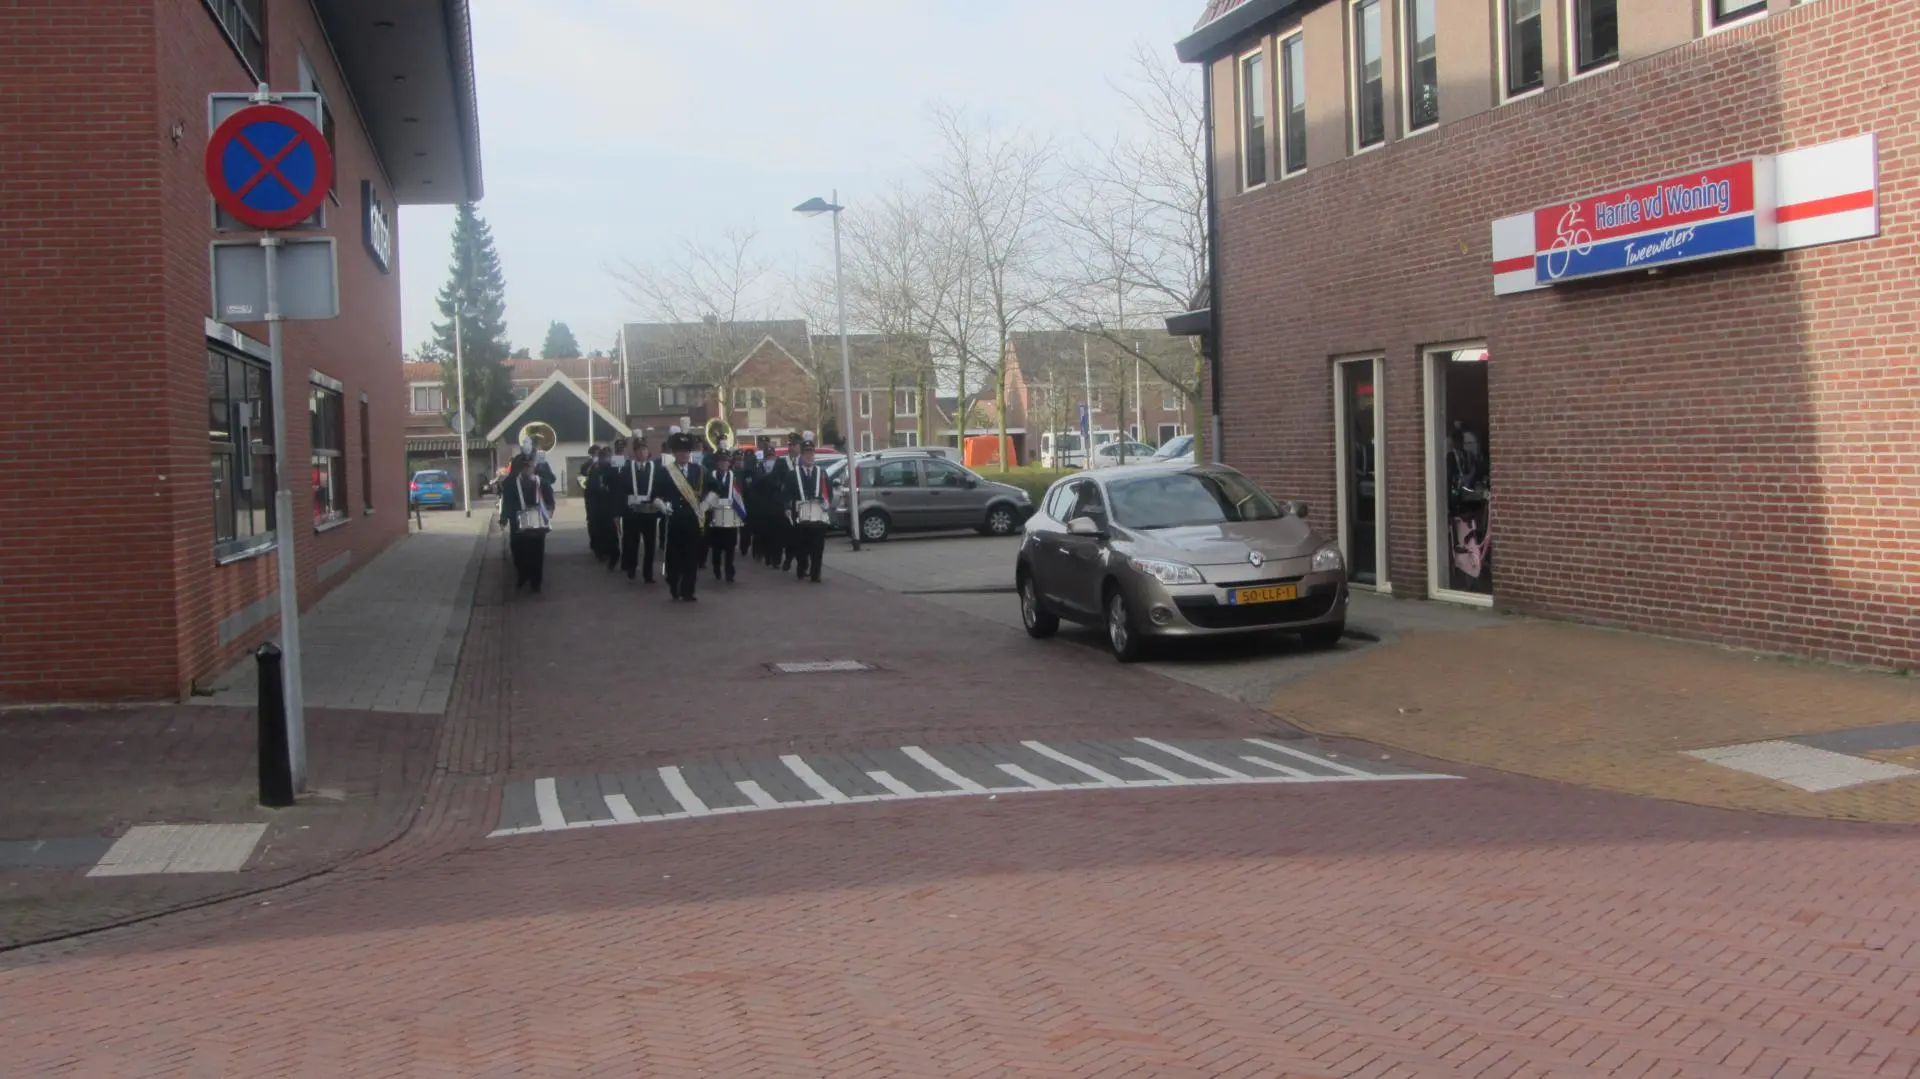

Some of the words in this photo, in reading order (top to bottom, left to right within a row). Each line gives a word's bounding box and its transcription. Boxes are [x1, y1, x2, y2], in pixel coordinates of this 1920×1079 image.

[1595, 194, 1640, 230] Harrie
[1643, 186, 1663, 220] vd
[1666, 177, 1729, 214] Woning
[1624, 225, 1695, 266] Tweewielers
